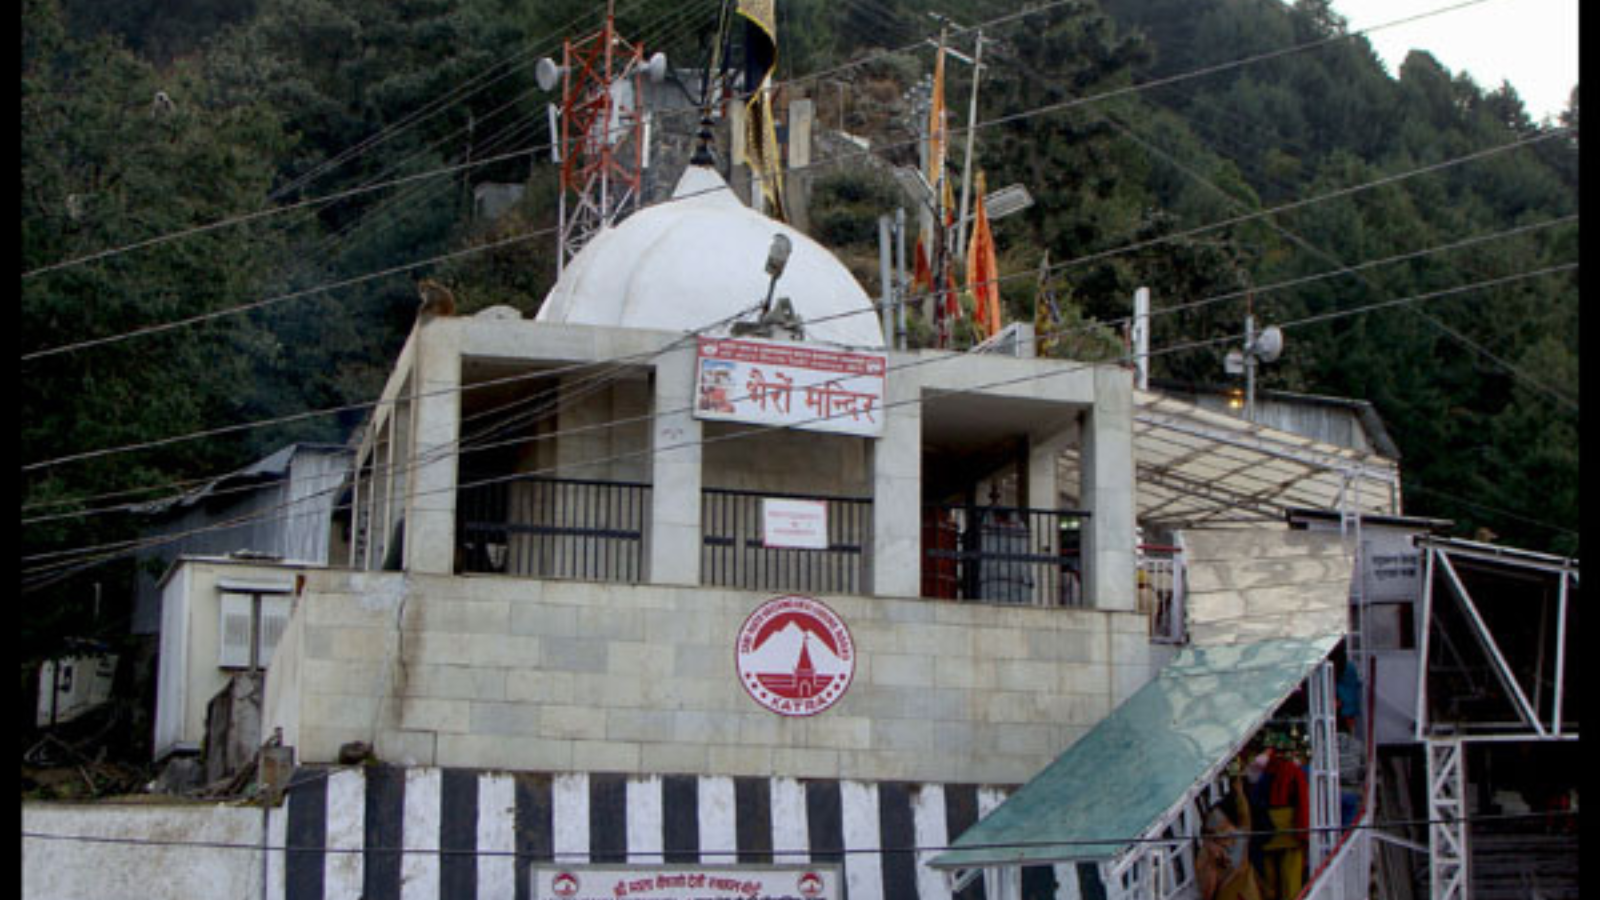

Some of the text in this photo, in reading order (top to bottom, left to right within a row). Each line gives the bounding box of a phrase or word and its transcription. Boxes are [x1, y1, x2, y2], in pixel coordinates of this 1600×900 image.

[747, 368, 878, 423] भैरों मन्दिर
[771, 696, 827, 713] KATRA
